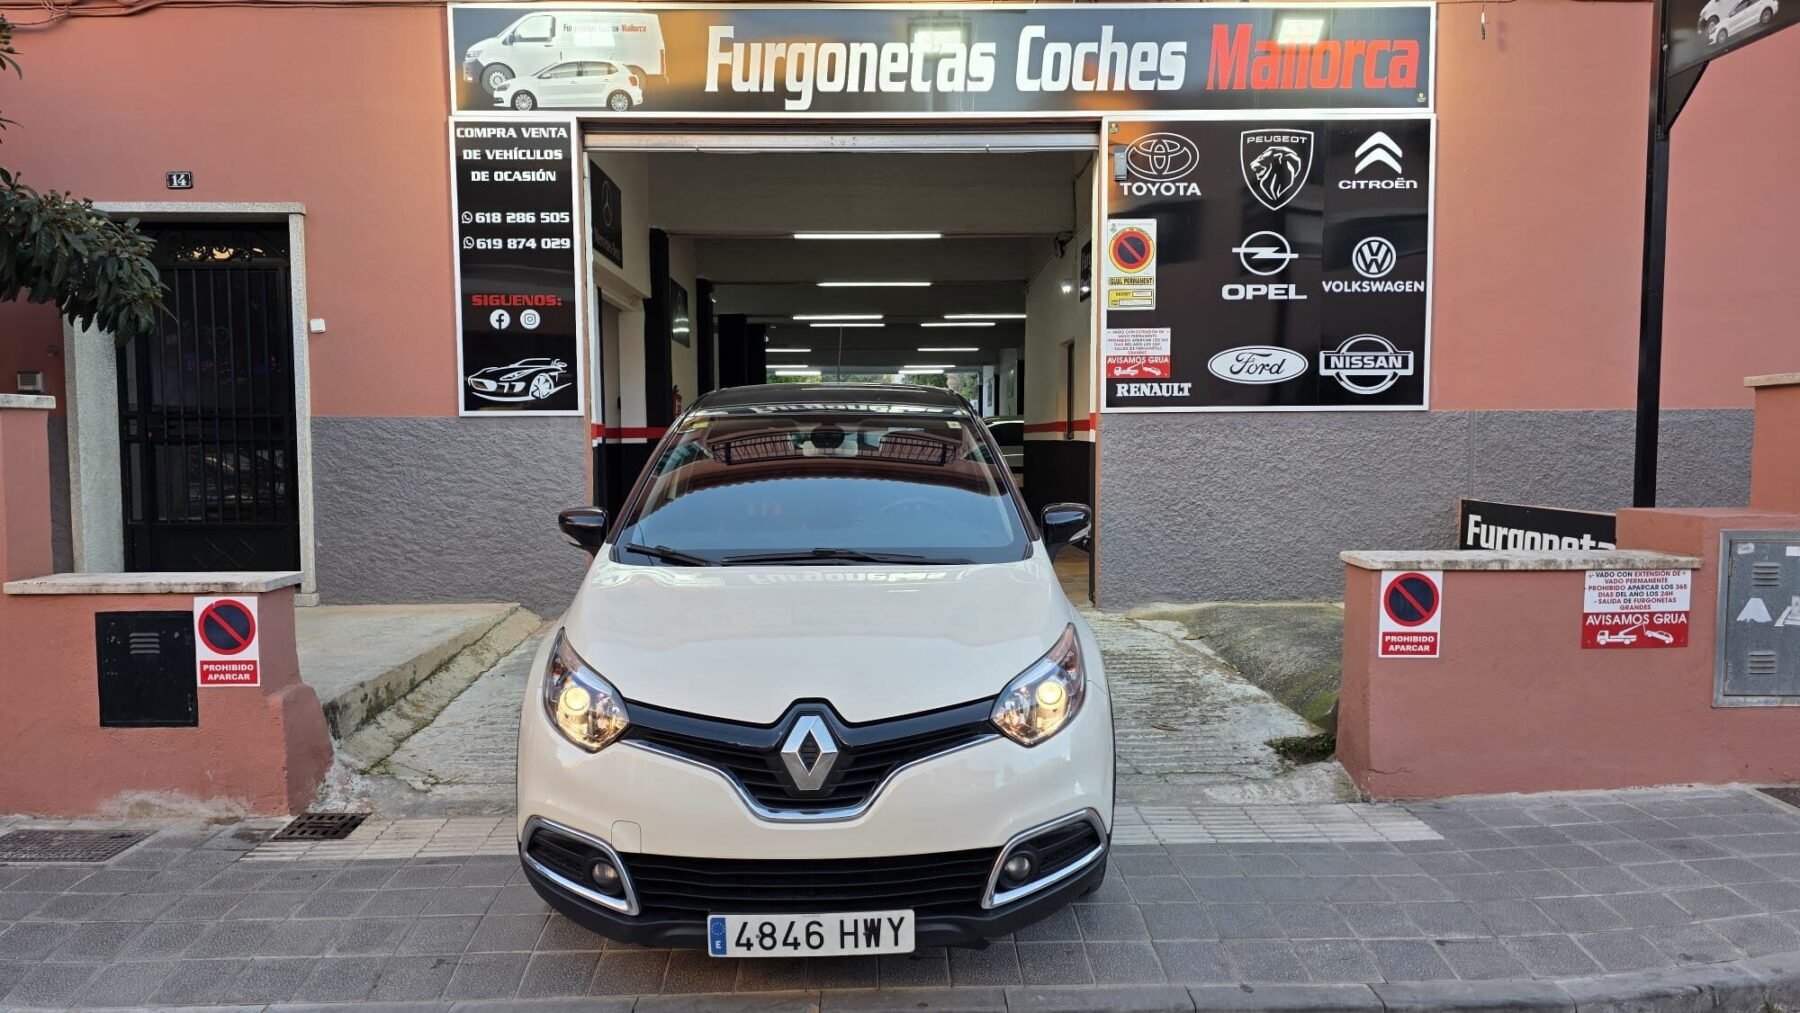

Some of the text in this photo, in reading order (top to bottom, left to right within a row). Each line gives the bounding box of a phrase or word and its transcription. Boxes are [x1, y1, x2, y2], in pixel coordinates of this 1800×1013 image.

[704, 23, 1420, 111] Furgonetas Coches Mallorca
[456, 127, 568, 139] COMPRA VENTA
[1246, 135, 1308, 145] PEUGEOT
[462, 147, 563, 160] DE VEHÍCULOS
[172, 174, 187, 186] 14
[471, 169, 557, 182] DE OCASIÓN
[1120, 182, 1202, 197] TOYOTA
[475, 212, 570, 223] 618 286 505
[476, 238, 571, 249] 619 874 029
[1221, 283, 1308, 300] OPEL
[1322, 280, 1425, 293] VOLKSWAGEN
[472, 294, 562, 306] SIGUENOS:
[1107, 356, 1170, 364] AVISAMOS GRUA
[1229, 353, 1286, 376] Ford
[1330, 355, 1403, 369] NISSAN
[1116, 383, 1192, 397] RENAULT
[1586, 613, 1687, 626] AVISAMOS GRUA
[1384, 635, 1435, 643] PROHIBIDO
[1388, 644, 1430, 652] APARCAR
[207, 673, 250, 681] APARCAR
[735, 920, 825, 951] 4846
[839, 916, 905, 949] HWY
